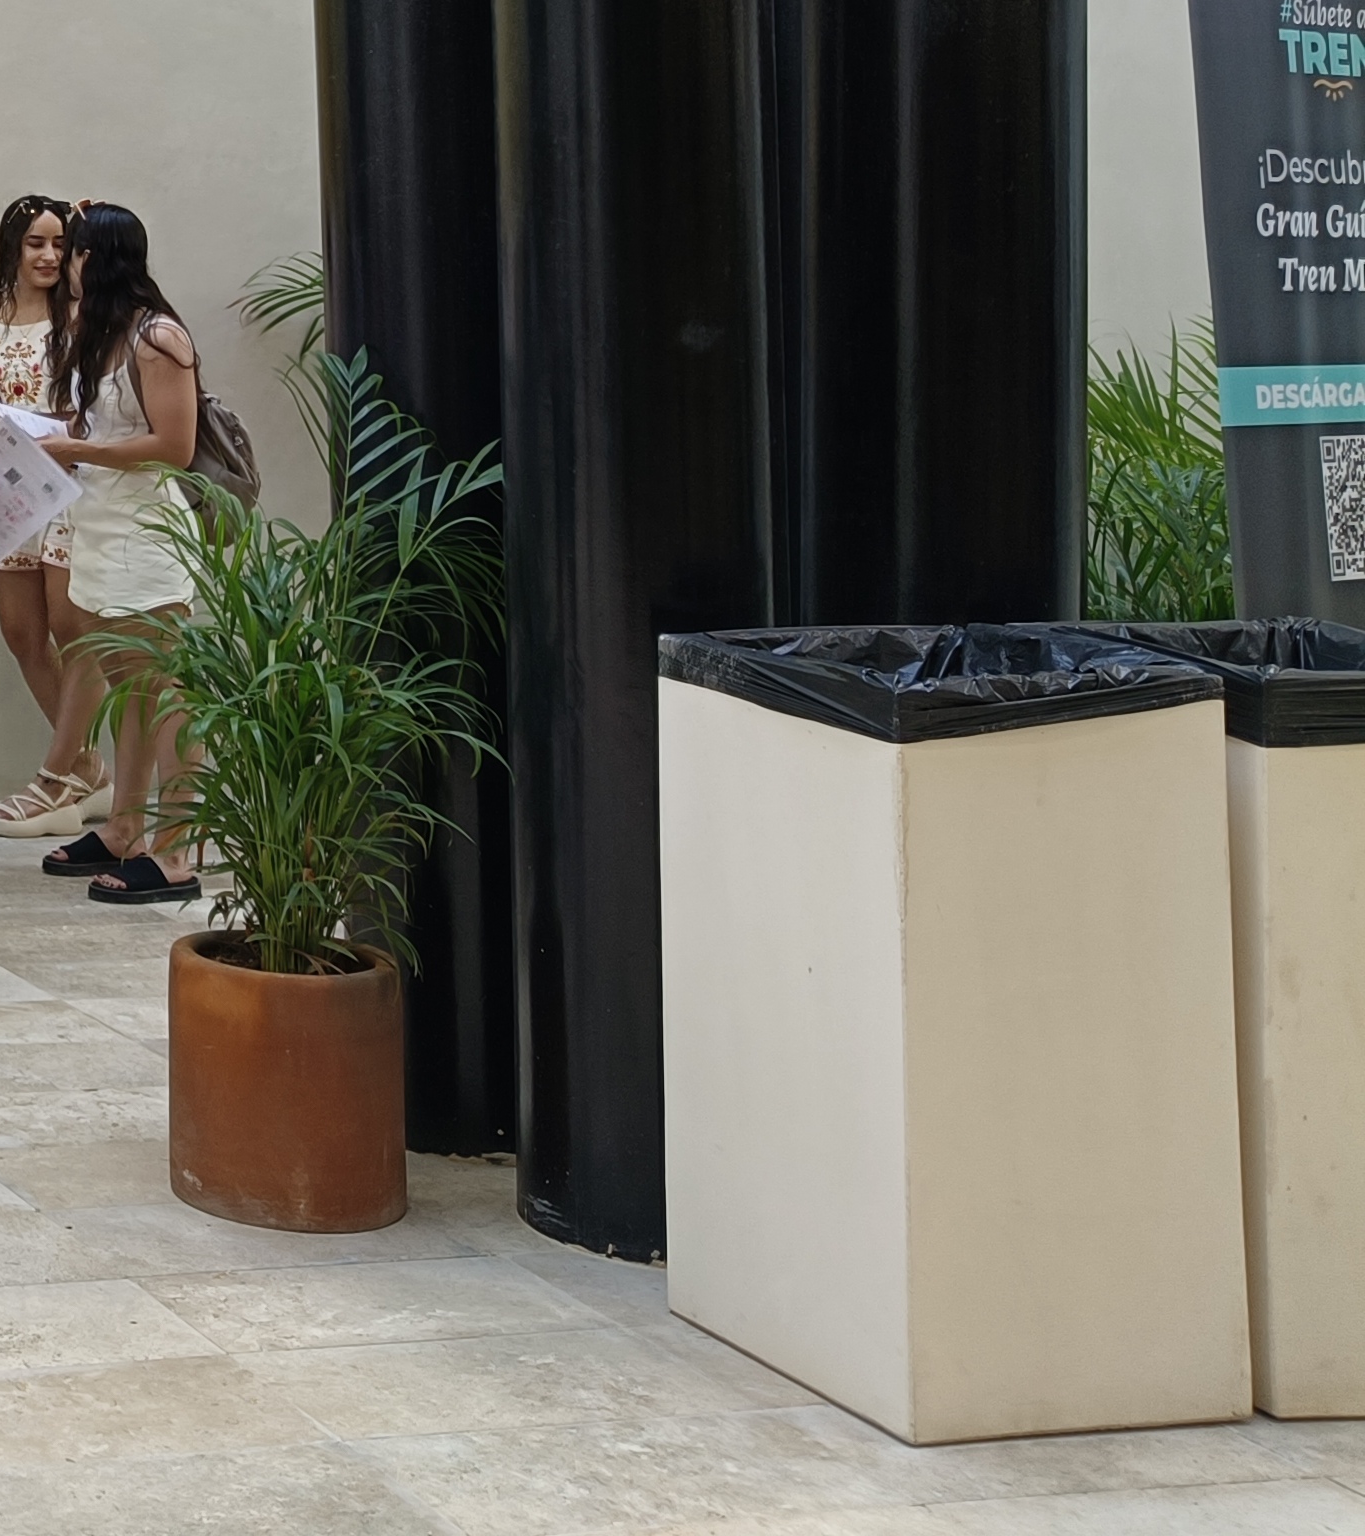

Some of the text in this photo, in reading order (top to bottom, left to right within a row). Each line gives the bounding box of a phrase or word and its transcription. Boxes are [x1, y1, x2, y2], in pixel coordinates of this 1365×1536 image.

[1278, 28, 1365, 77] TREN
[1258, 149, 1365, 189] ¡Descub
[1256, 203, 1319, 238] Gran
[1278, 257, 1365, 292] Tren M
[1255, 375, 1365, 410] DESCÁRGA
